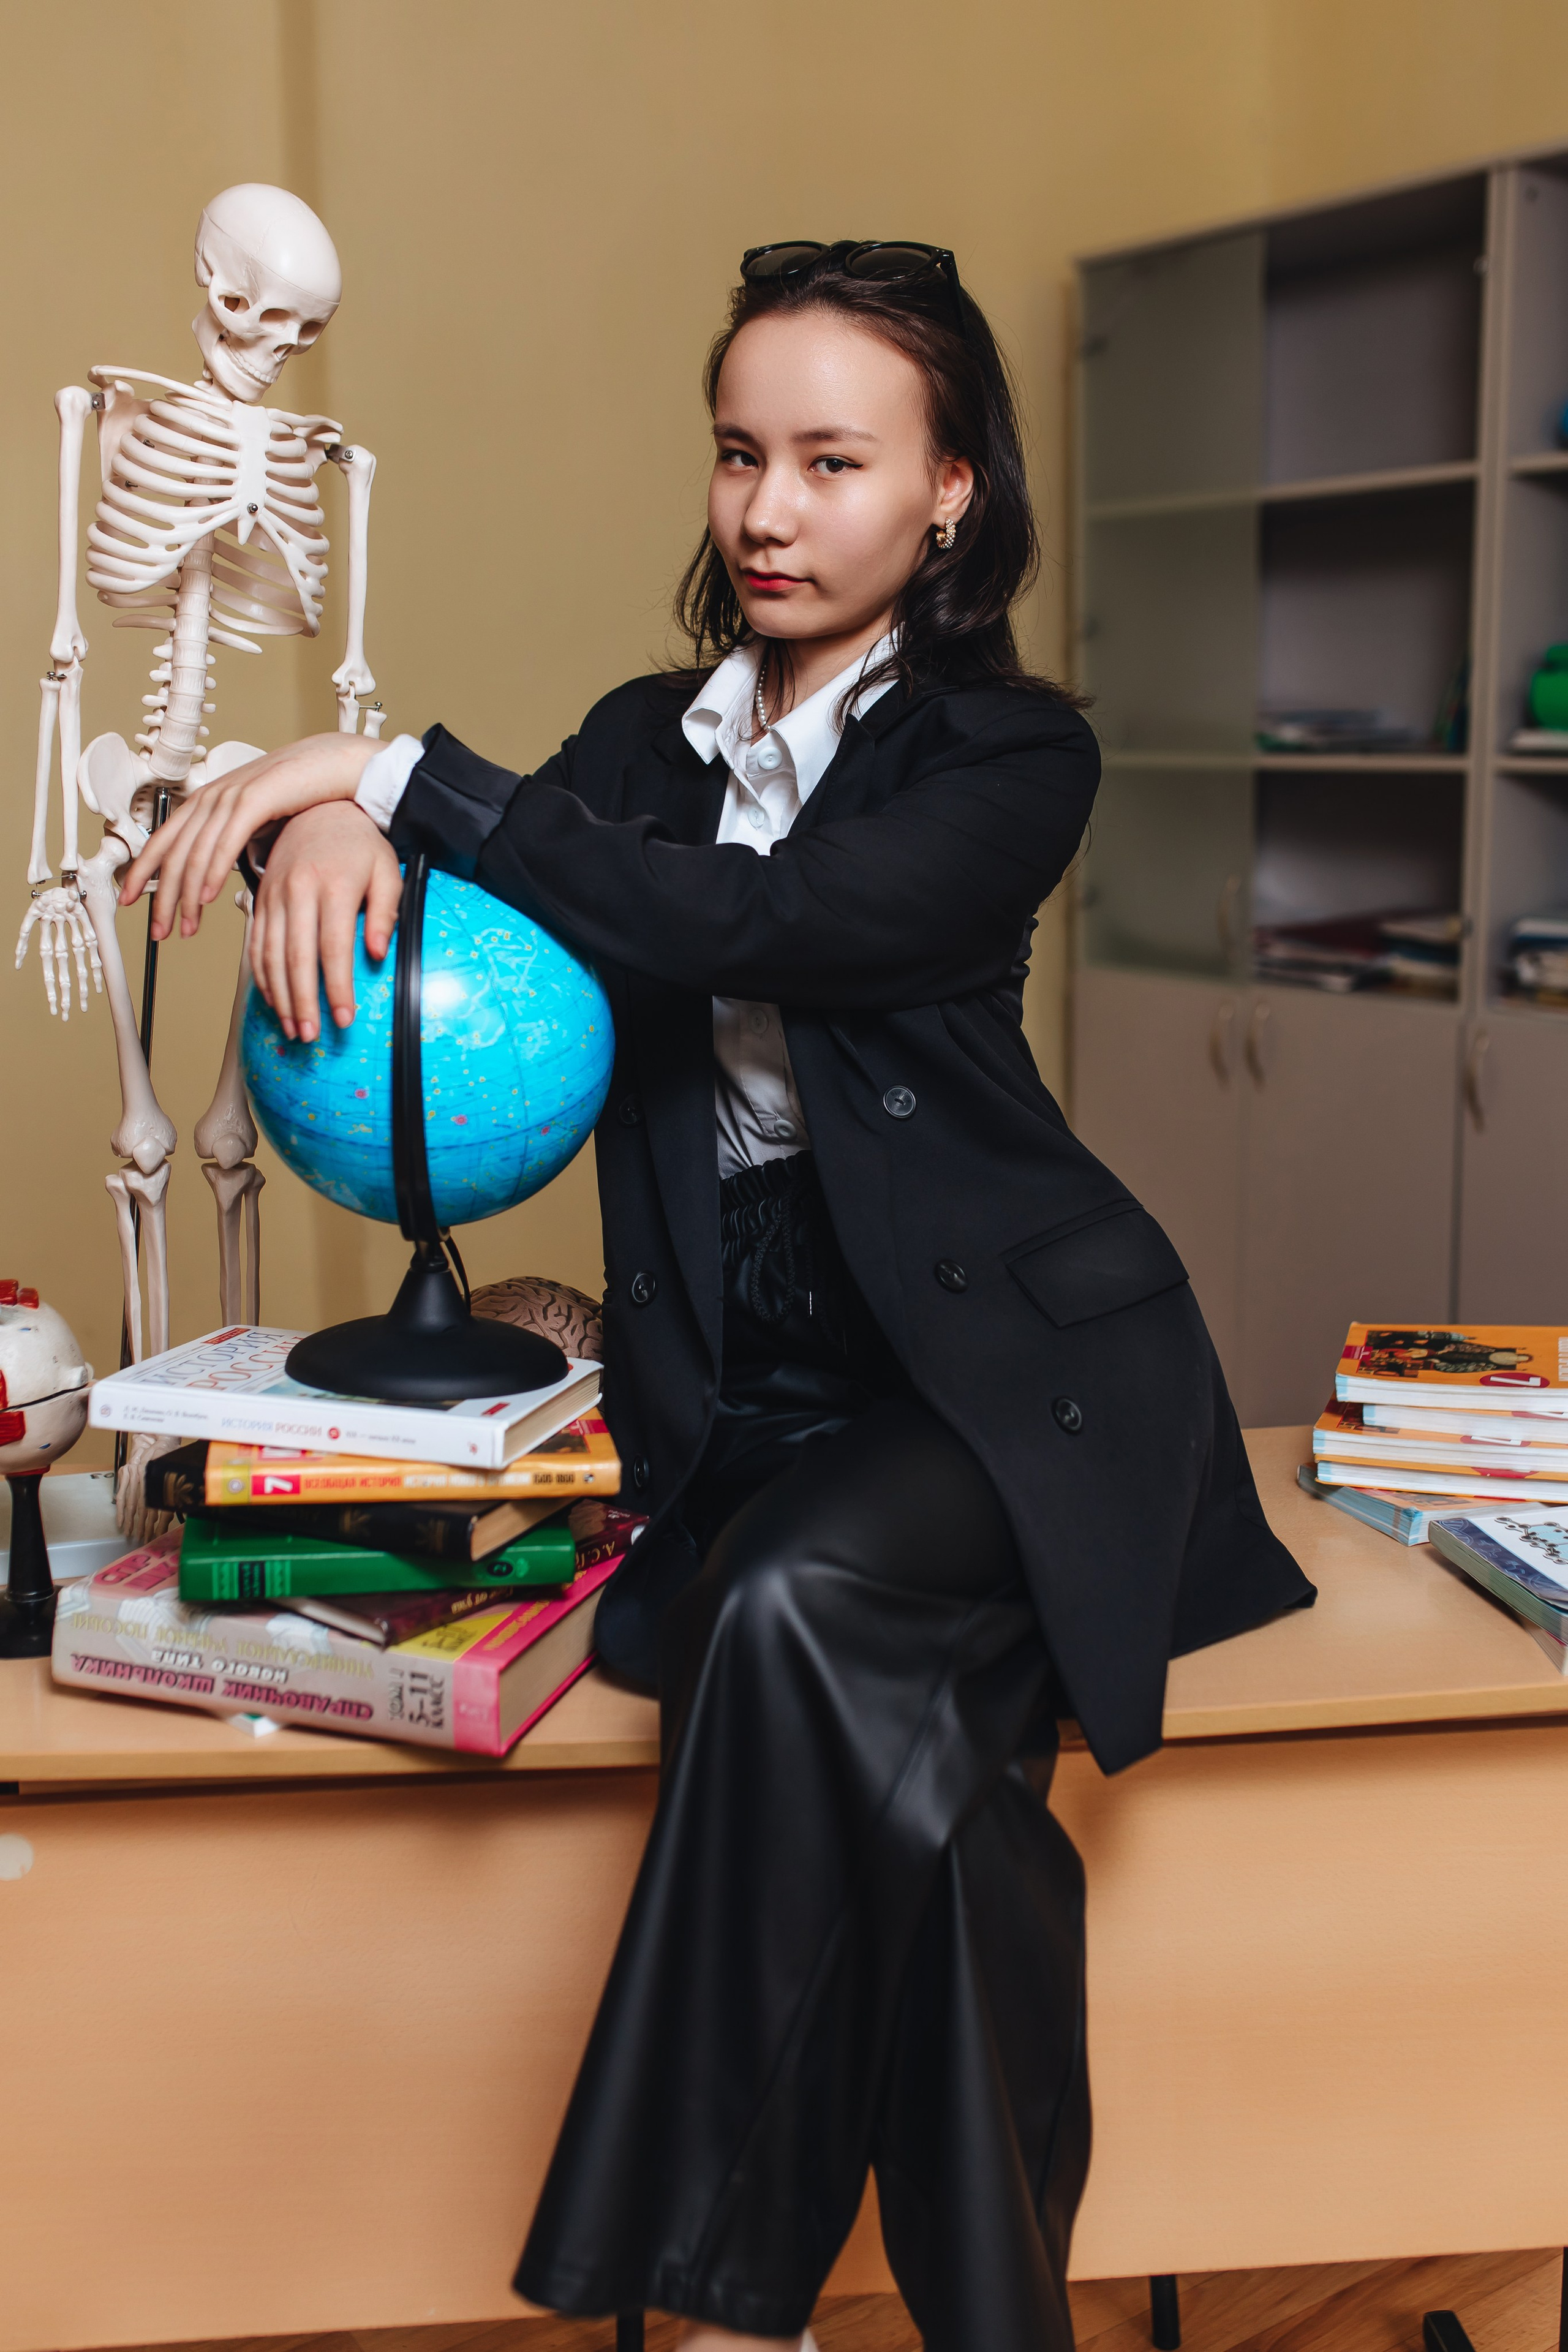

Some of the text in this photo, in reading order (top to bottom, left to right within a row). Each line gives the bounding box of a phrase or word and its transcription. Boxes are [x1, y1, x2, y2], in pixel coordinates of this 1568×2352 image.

[140, 1332, 285, 1385] ИСТОРИЯ
[1490, 1376, 1542, 1387] 7
[221, 1417, 274, 1433] ИСТОРИЯ
[274, 1421, 323, 1438] РОССИИ
[264, 1476, 293, 1494] 7
[359, 1476, 402, 1489] ИСТОРИЯ
[71, 1613, 148, 1641] ПОСОБИЕ
[155, 1626, 228, 1654] УЧЕБНОЕ
[151, 1646, 288, 1684] нового типа
[70, 1654, 374, 1721] СПРАВОЧНИК ШКОЛЬНИКА
